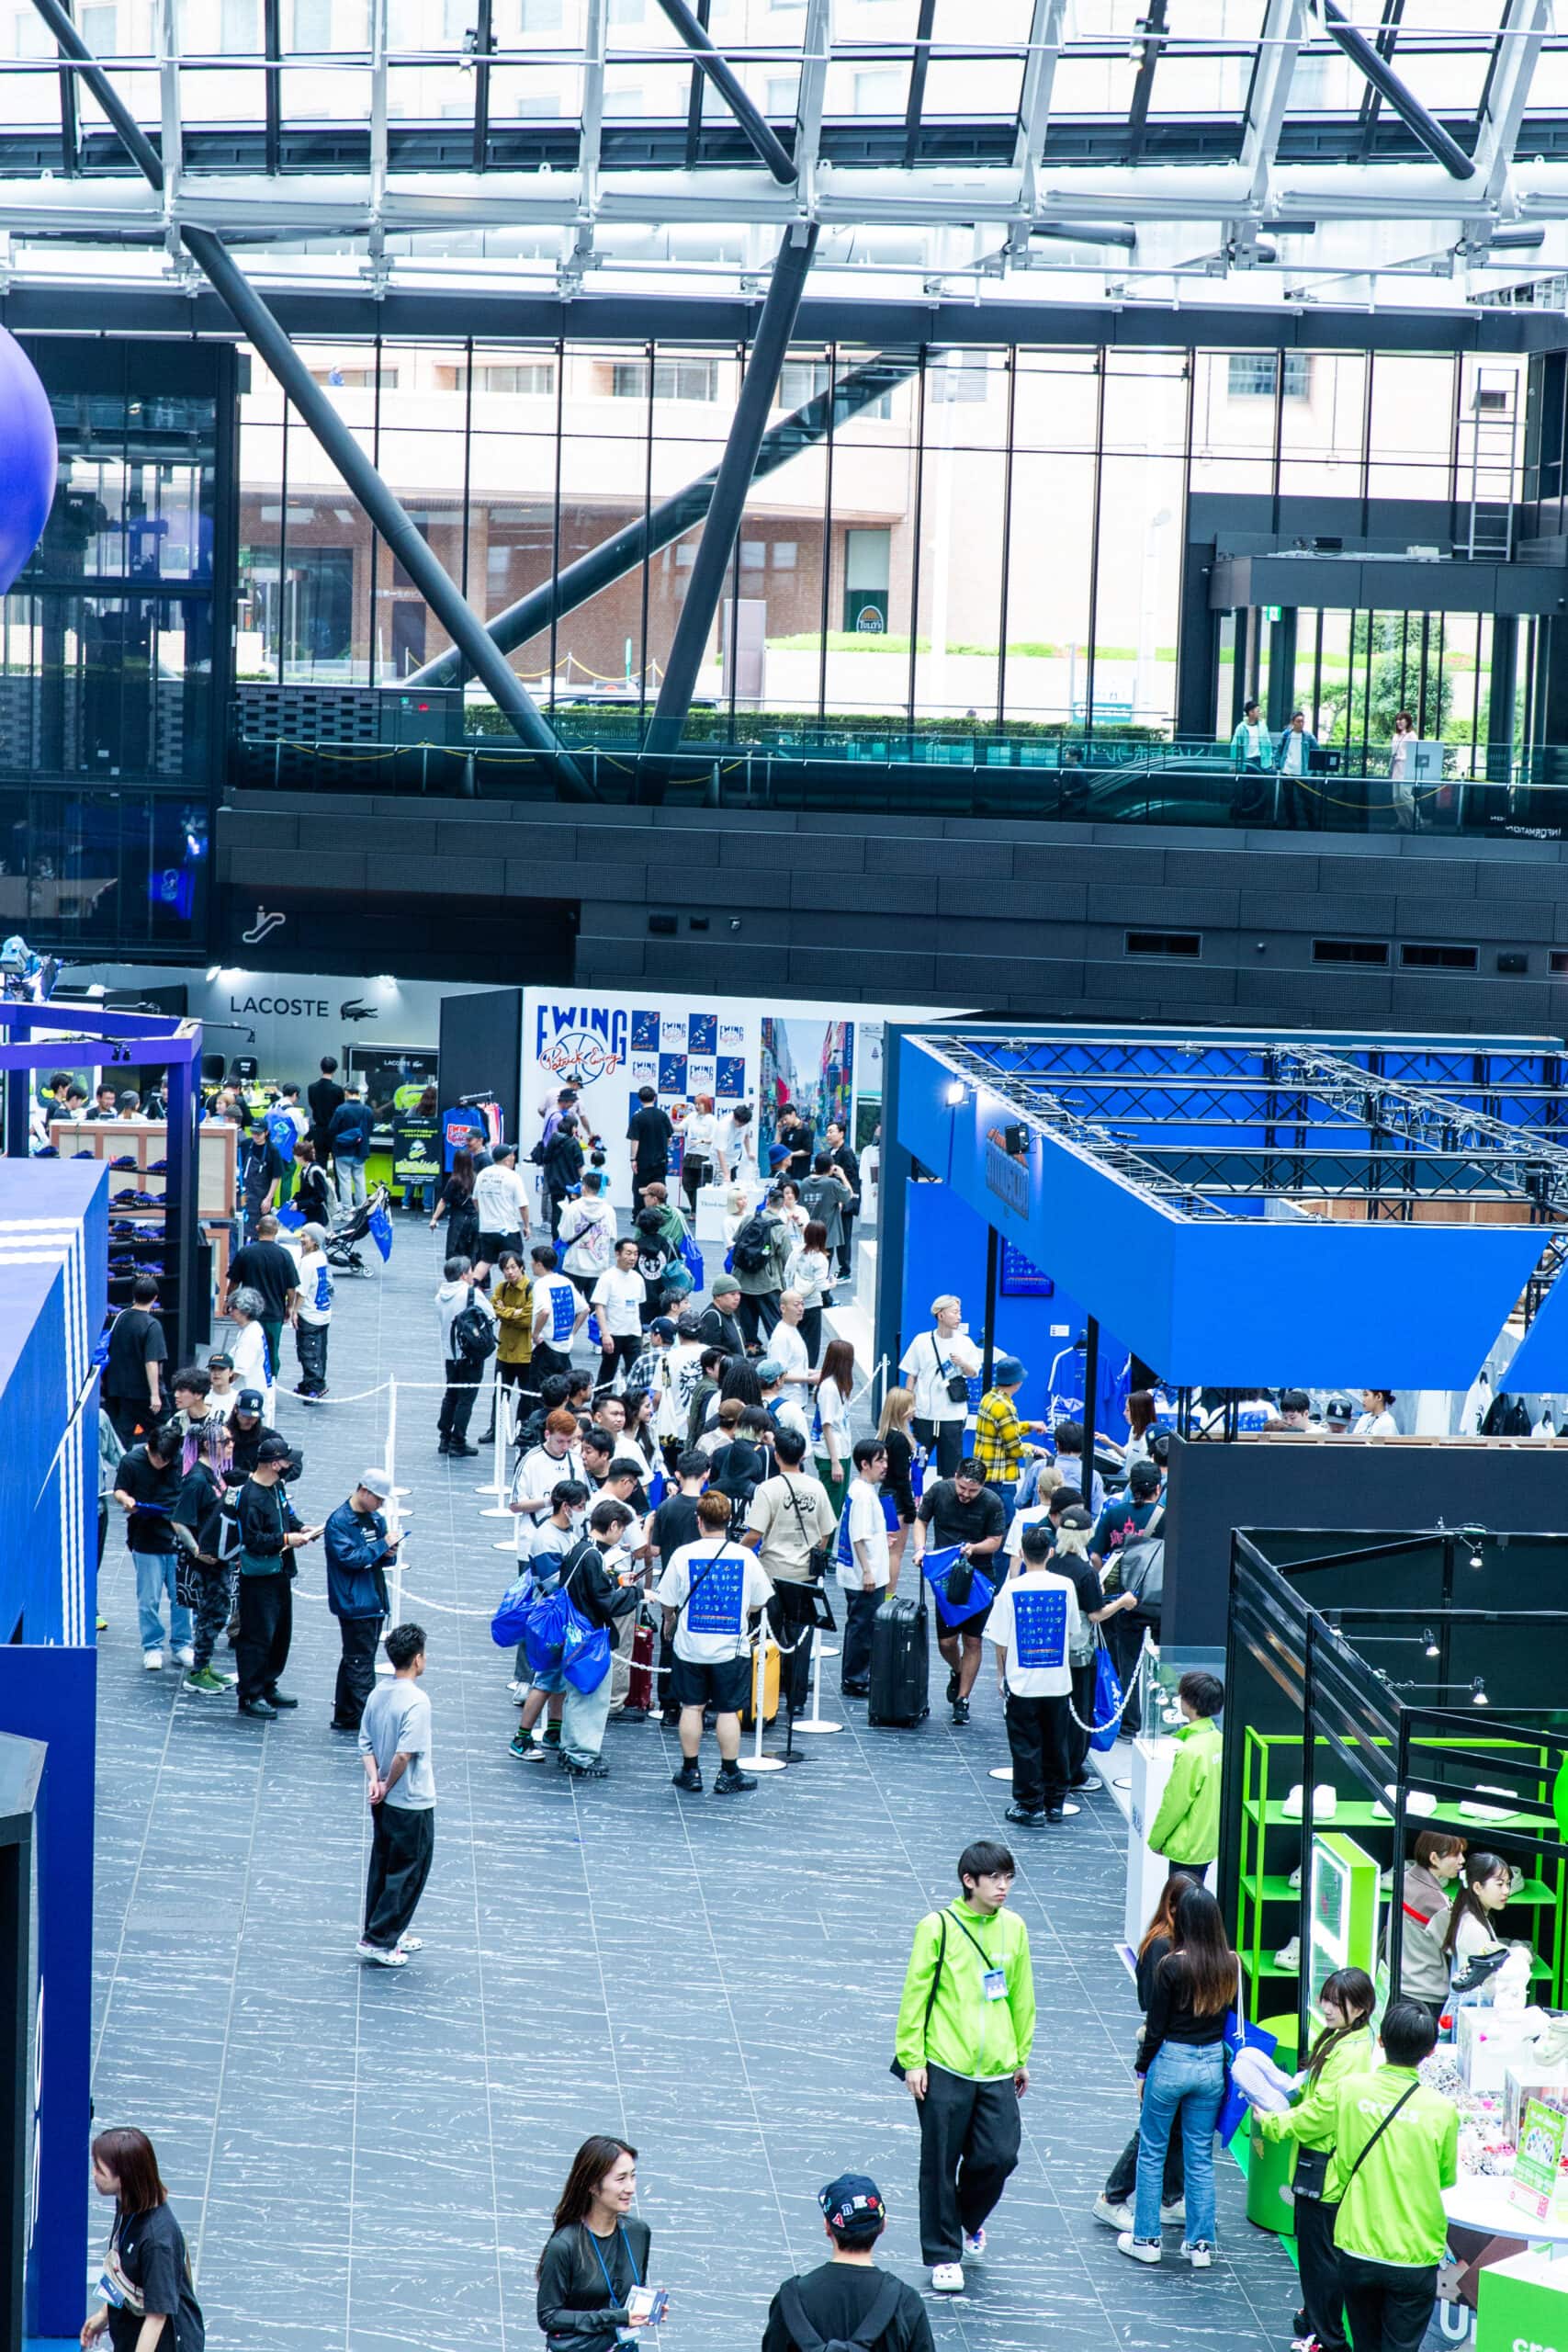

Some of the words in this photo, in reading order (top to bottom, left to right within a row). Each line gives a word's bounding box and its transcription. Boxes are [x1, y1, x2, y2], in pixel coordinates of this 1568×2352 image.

[231, 996, 329, 1017] LACOSTE
[536, 1005, 627, 1066] EWING
[539, 1046, 590, 1071] Patrick
[1439, 2298, 1478, 2346] U
